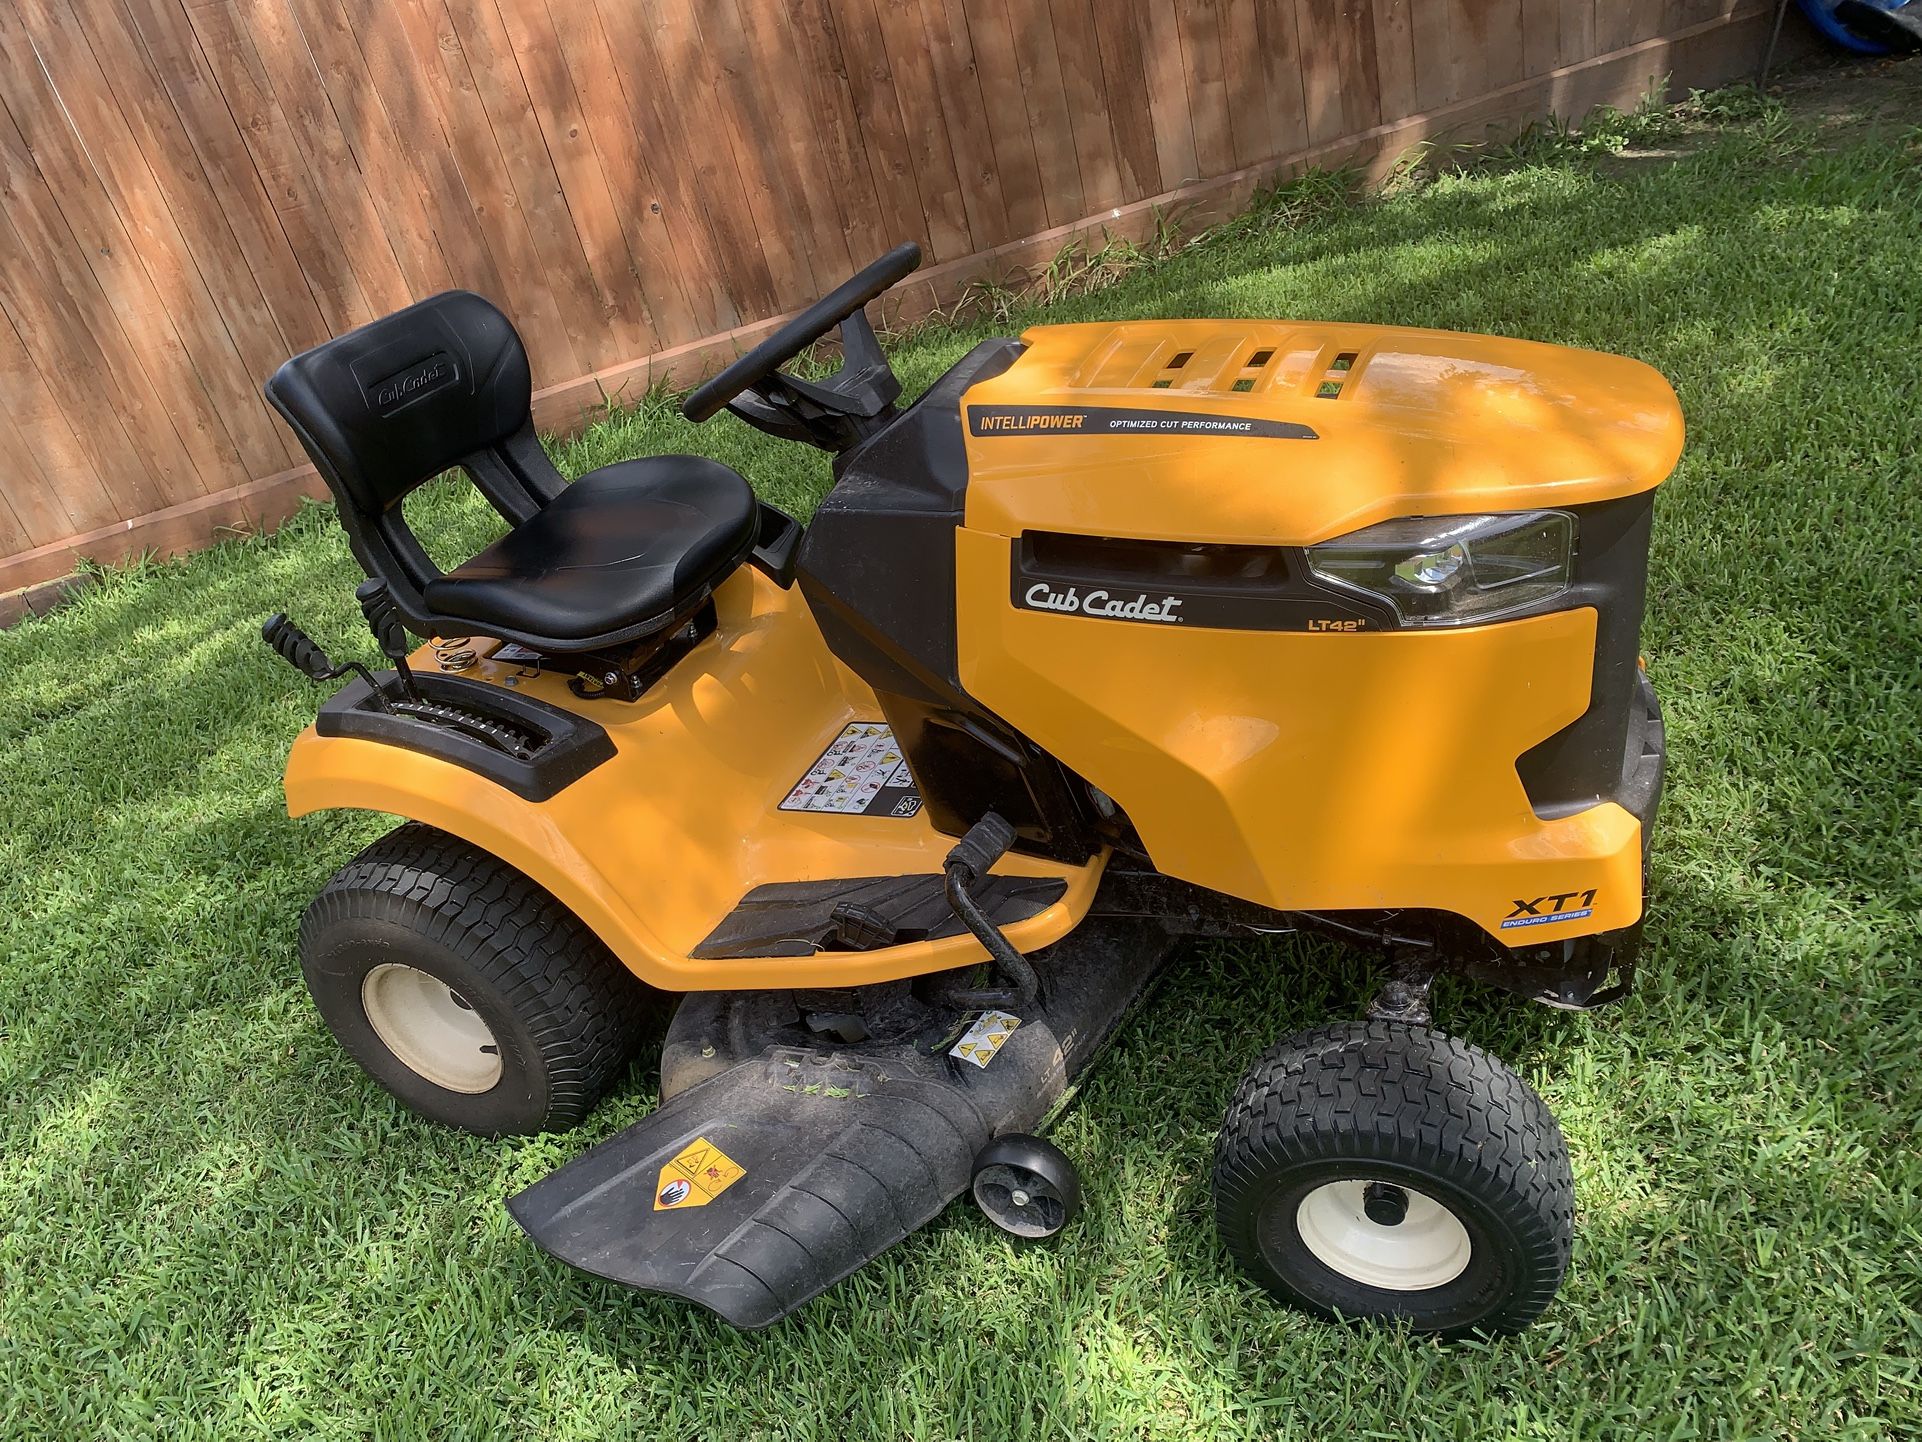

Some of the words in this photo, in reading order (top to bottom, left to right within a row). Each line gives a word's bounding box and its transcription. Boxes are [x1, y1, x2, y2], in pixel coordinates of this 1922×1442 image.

[1109, 420, 1158, 428] OPTIMIZED
[1181, 421, 1252, 431] PERFORMANCE
[1025, 583, 1080, 612] Cub
[1082, 590, 1182, 622] Cadet
[1504, 888, 1598, 918] XT1
[1503, 916, 1548, 928] ENDURO
[1550, 910, 1588, 921] SERIES
